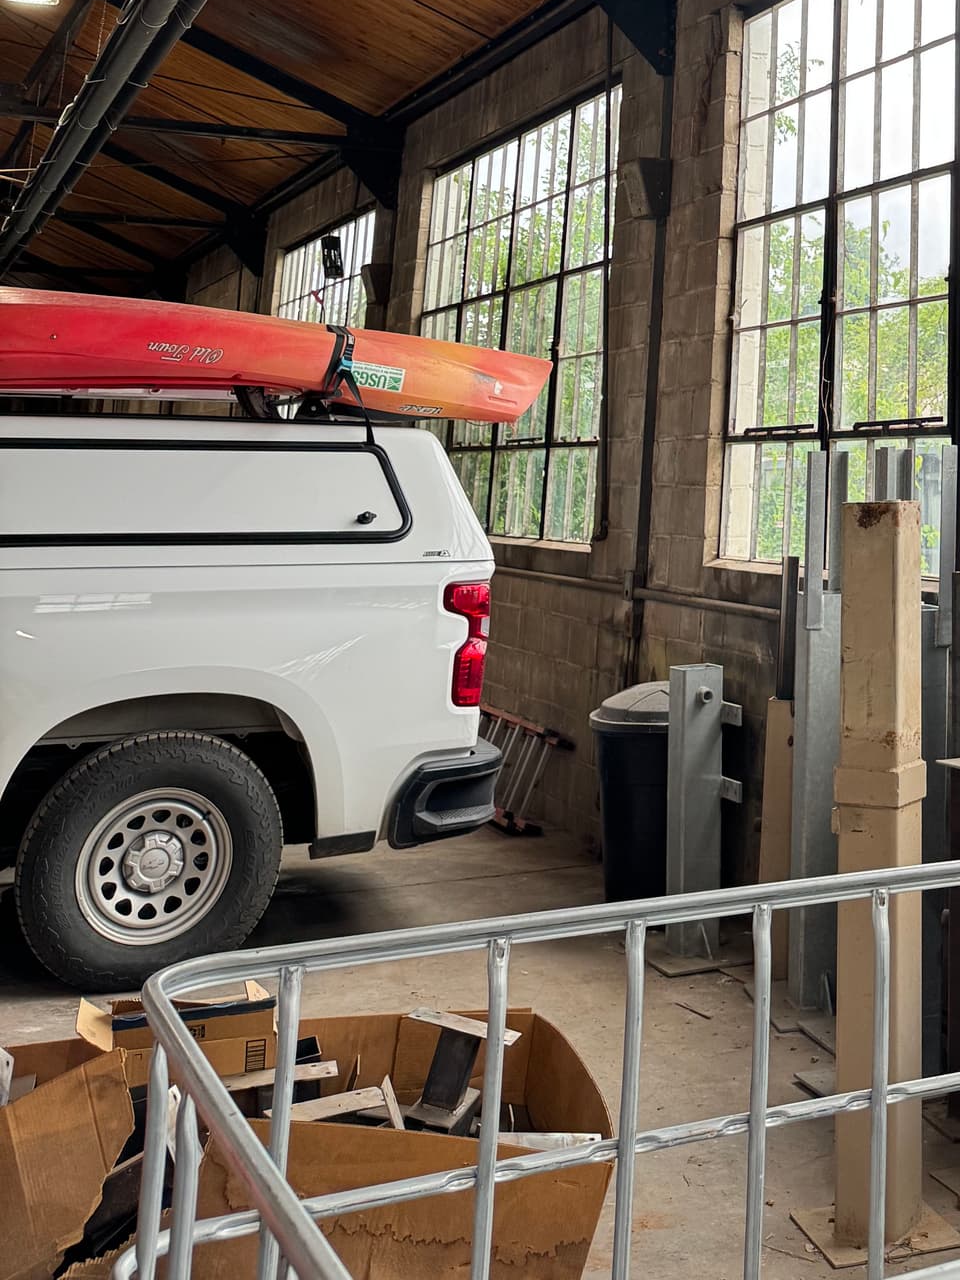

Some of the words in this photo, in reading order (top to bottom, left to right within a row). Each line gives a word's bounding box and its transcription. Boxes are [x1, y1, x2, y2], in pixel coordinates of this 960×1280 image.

[147, 341, 190, 362] Town
[189, 346, 224, 365] Old
[352, 370, 387, 389] USGS
